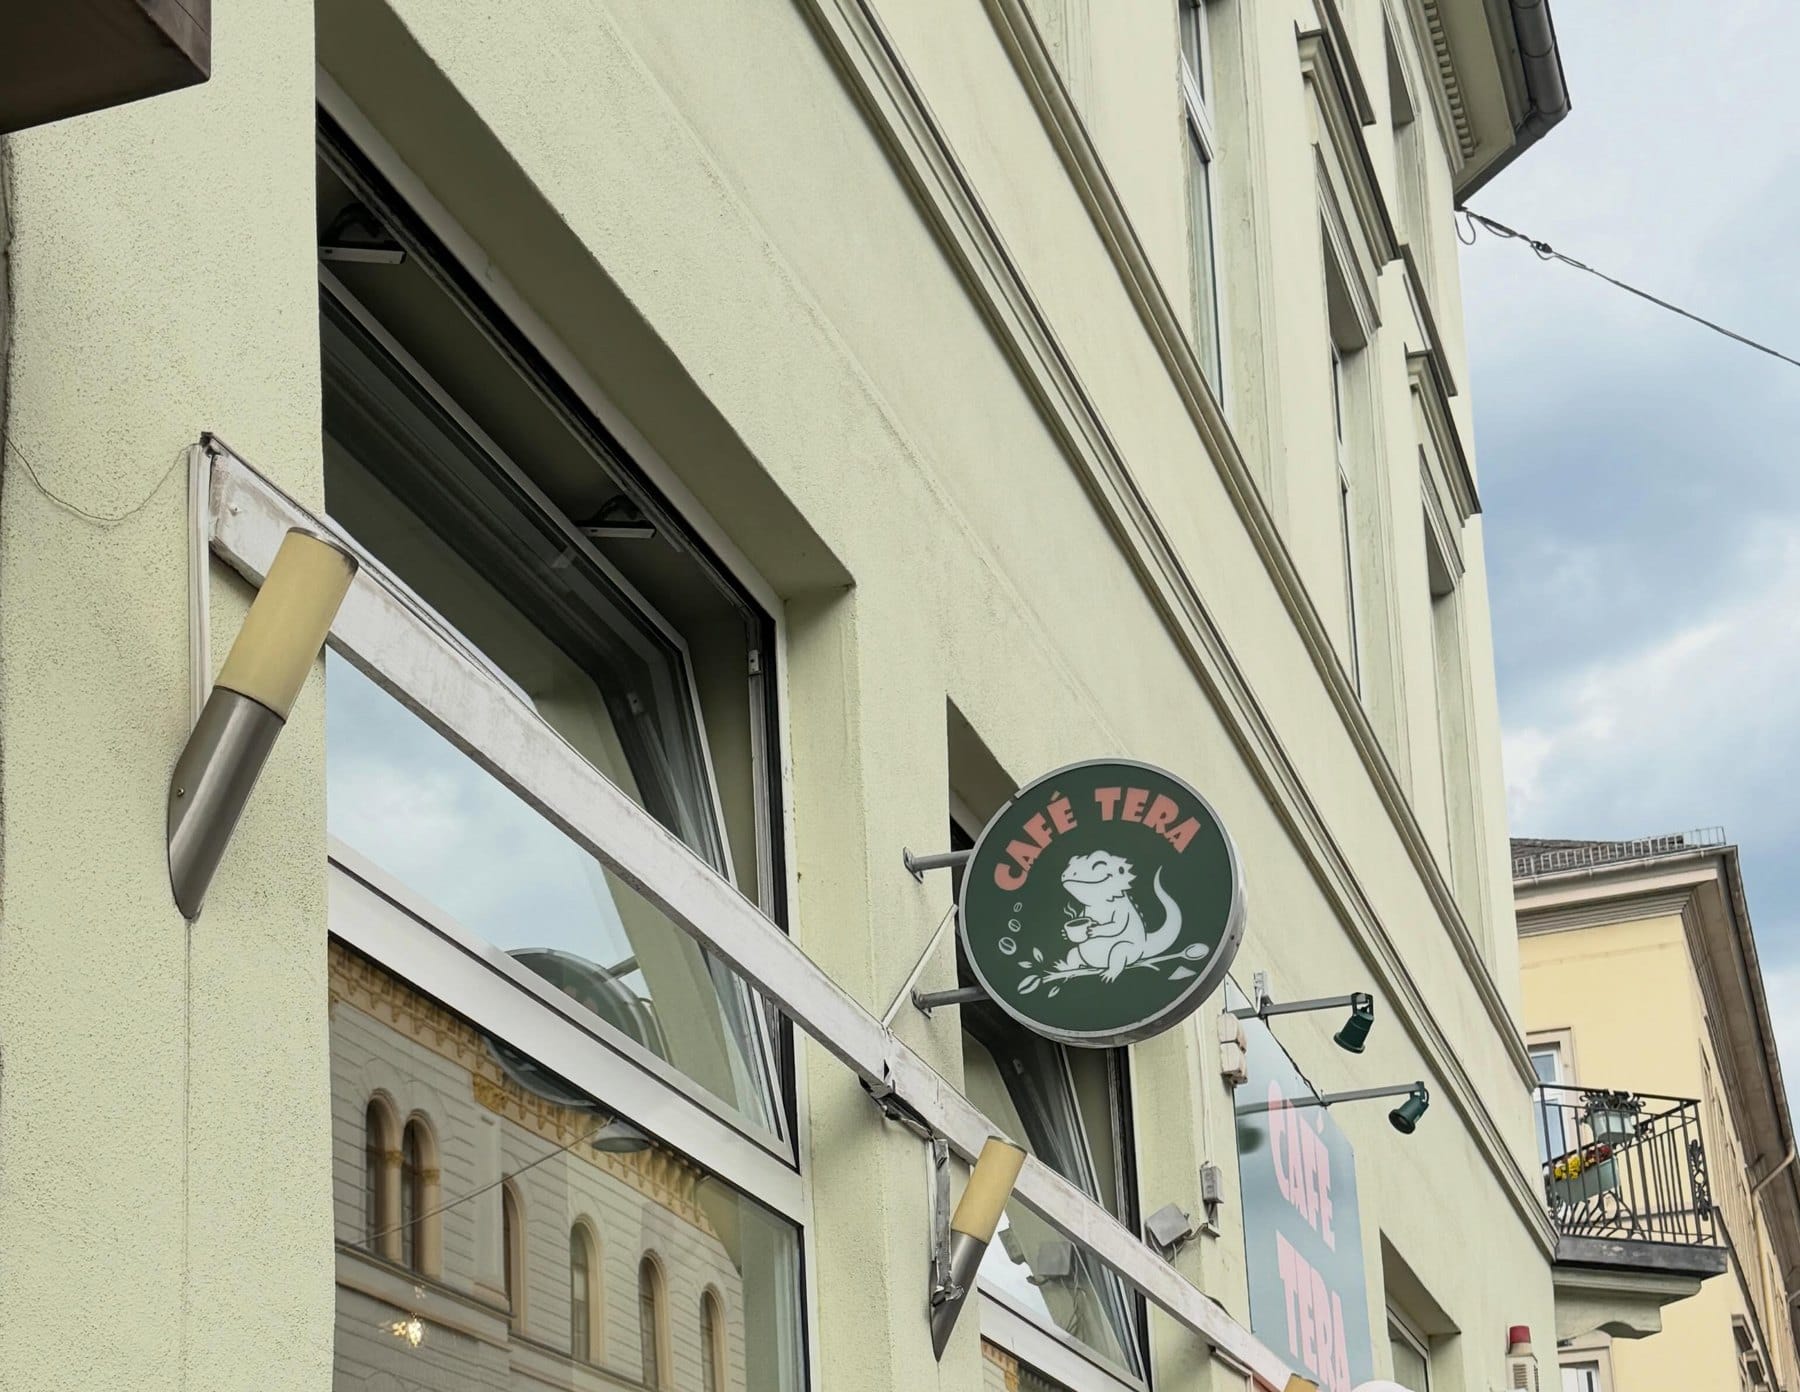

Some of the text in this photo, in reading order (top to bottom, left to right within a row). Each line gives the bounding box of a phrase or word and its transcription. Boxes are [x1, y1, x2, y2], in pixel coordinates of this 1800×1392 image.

[994, 787, 1201, 891] CAFÉ TERA
[1268, 1079, 1336, 1253] CAFÉ
[1276, 1230, 1351, 1392] TERA
